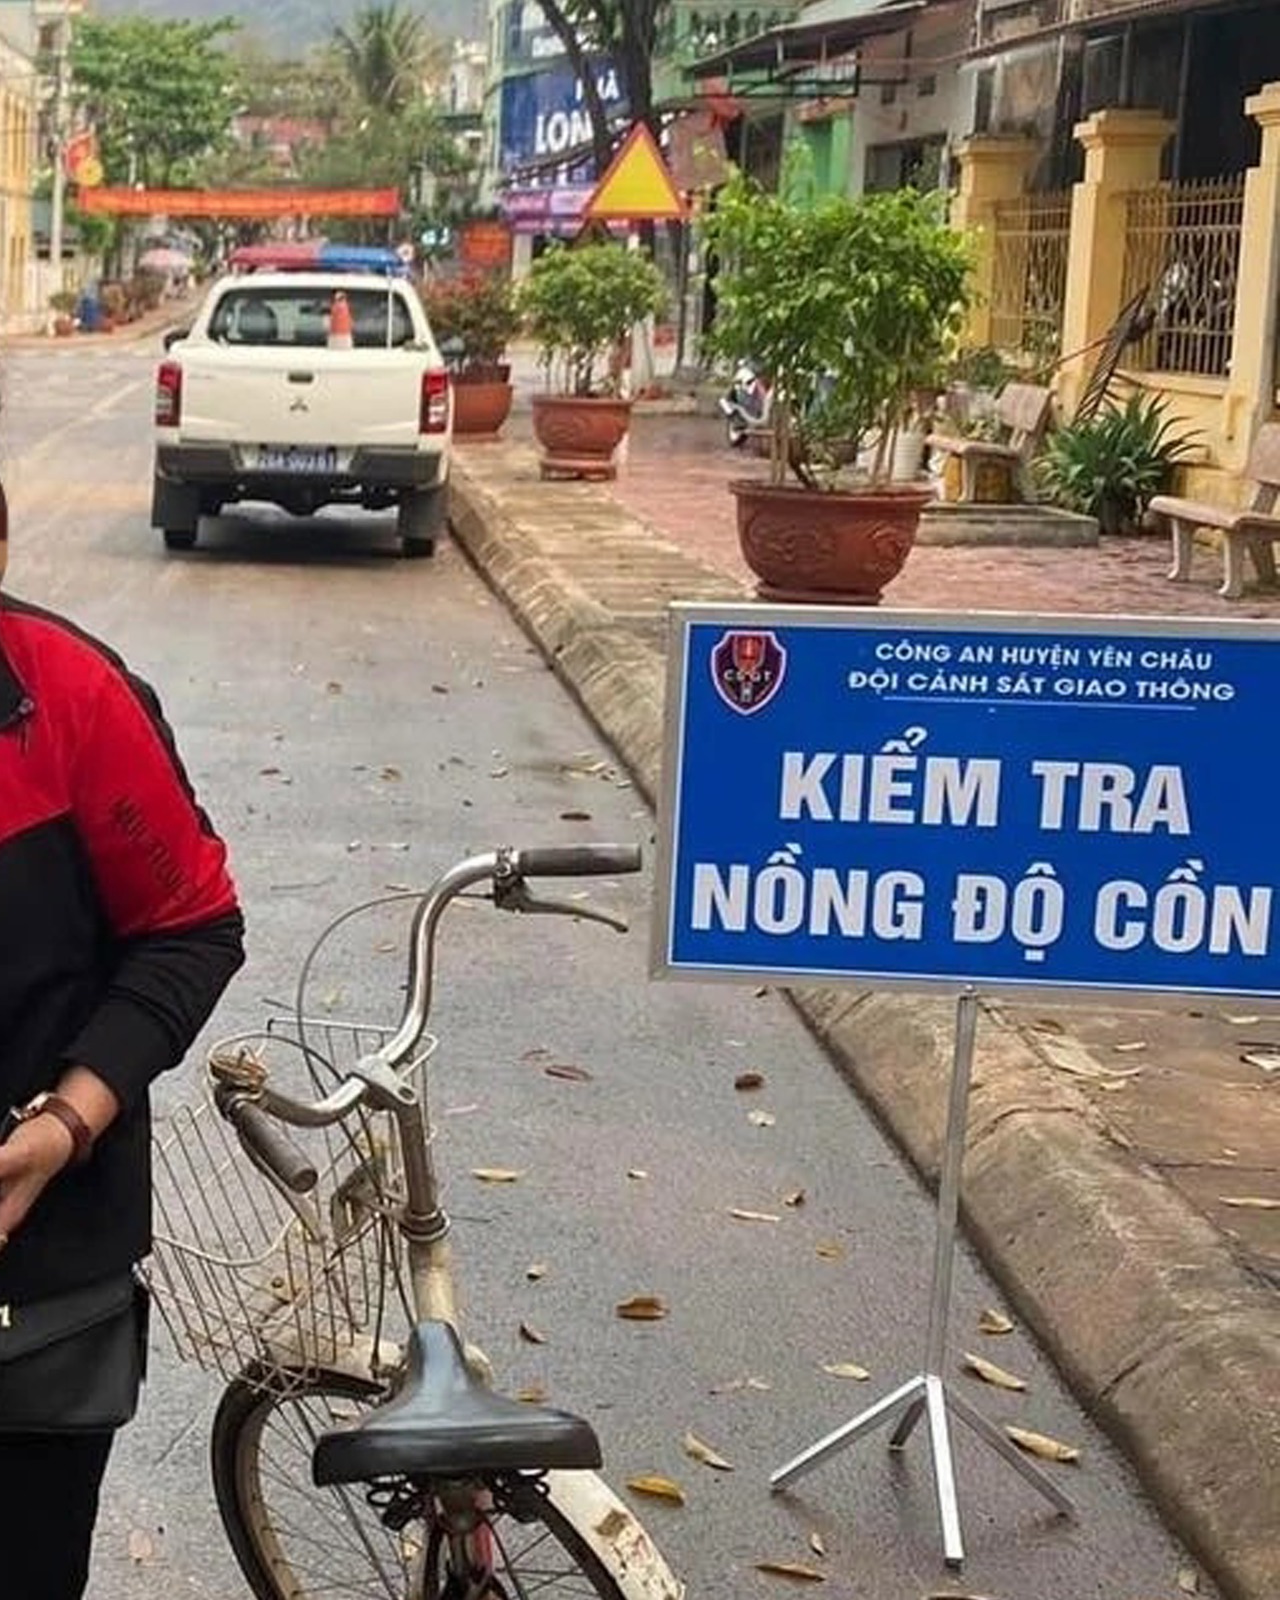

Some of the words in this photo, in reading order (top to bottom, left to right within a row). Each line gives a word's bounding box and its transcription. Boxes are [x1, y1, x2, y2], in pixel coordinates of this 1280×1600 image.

[535, 112, 595, 153] LON
[875, 639, 952, 662] CÔNG
[958, 646, 994, 663] AN
[1001, 643, 1080, 671] HUYỆN
[1088, 645, 1133, 668] YÊN
[1140, 648, 1213, 671] CHÂU
[848, 667, 898, 695] ĐỘI
[907, 668, 989, 692] CẢNH
[996, 672, 1046, 694] SÁT
[1053, 678, 1128, 697] GIAO
[1135, 677, 1236, 701] THÔNG
[779, 726, 1002, 827] KIỂM
[1031, 760, 1191, 834] TRA
[691, 842, 925, 940] NỒNG
[952, 862, 1065, 961] ĐỘ
[1094, 859, 1273, 956] CỒN
